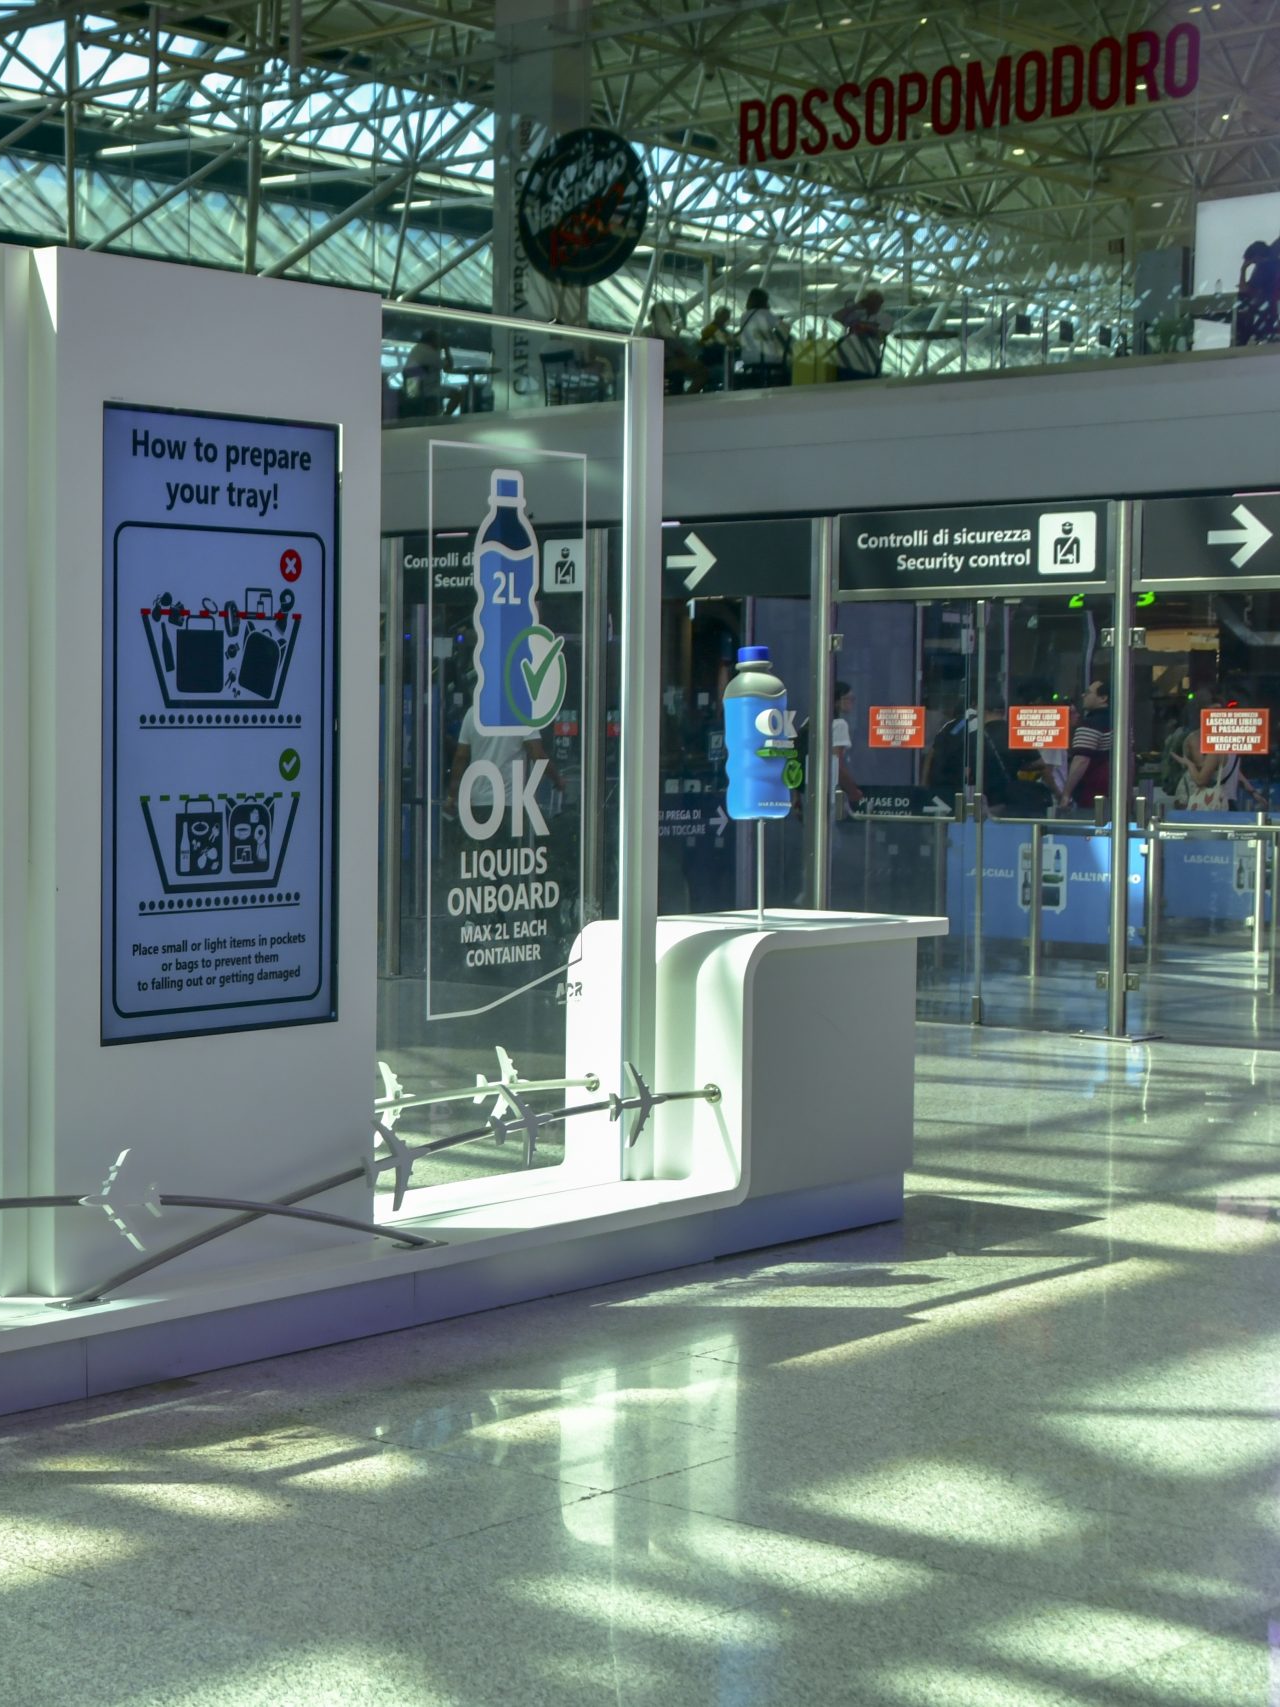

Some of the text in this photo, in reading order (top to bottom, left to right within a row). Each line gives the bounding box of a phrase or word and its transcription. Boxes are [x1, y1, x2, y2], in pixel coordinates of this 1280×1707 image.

[738, 22, 1200, 165] ROSSOPOMODORO
[513, 334, 529, 395] CAFF
[132, 428, 312, 475] How to prepare
[166, 481, 278, 516] your tray!
[857, 528, 1031, 549] Controlli di sicurezza
[896, 548, 1031, 573] Security control
[434, 574, 474, 588] Securi
[492, 571, 522, 605] 2L
[754, 708, 798, 738] OK
[458, 759, 551, 841] OK
[895, 798, 910, 807] DO
[666, 810, 691, 820] PREGA
[693, 809, 701, 819] DI
[659, 825, 706, 836] ON TOCCARE
[460, 846, 548, 880] LIQUIDS
[447, 881, 560, 916] ONBOARD
[132, 932, 306, 956] Place small or light items in pockets
[460, 919, 548, 943] MAX 2L EACH
[161, 951, 279, 973] or bags to prevent them
[466, 944, 541, 967] CONTAINER
[137, 965, 301, 992] to falling out or getting damaged
